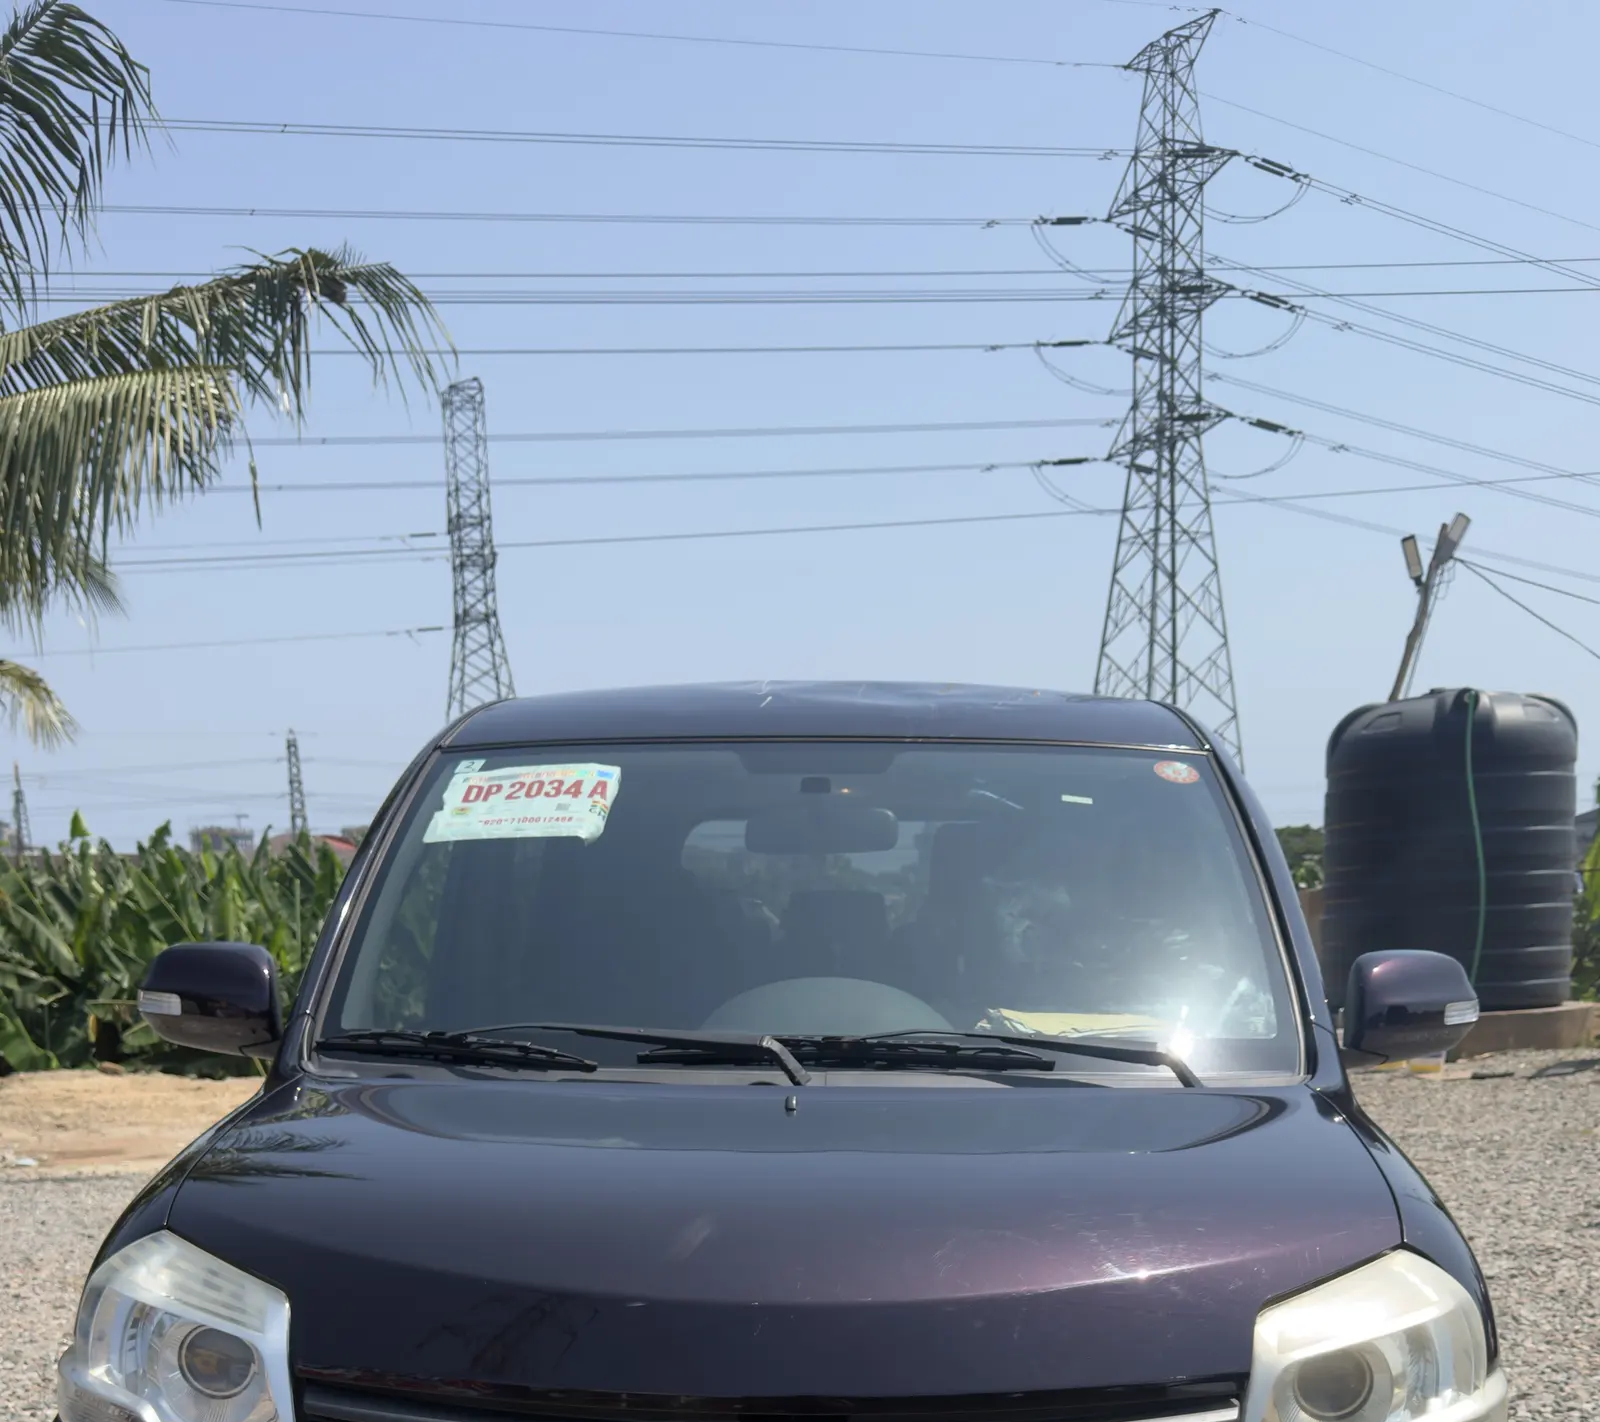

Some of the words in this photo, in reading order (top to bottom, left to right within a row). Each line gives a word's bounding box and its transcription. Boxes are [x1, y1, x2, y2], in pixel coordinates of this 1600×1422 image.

[461, 784, 504, 804] DP
[505, 779, 584, 801] 2034
[587, 780, 608, 801] A
